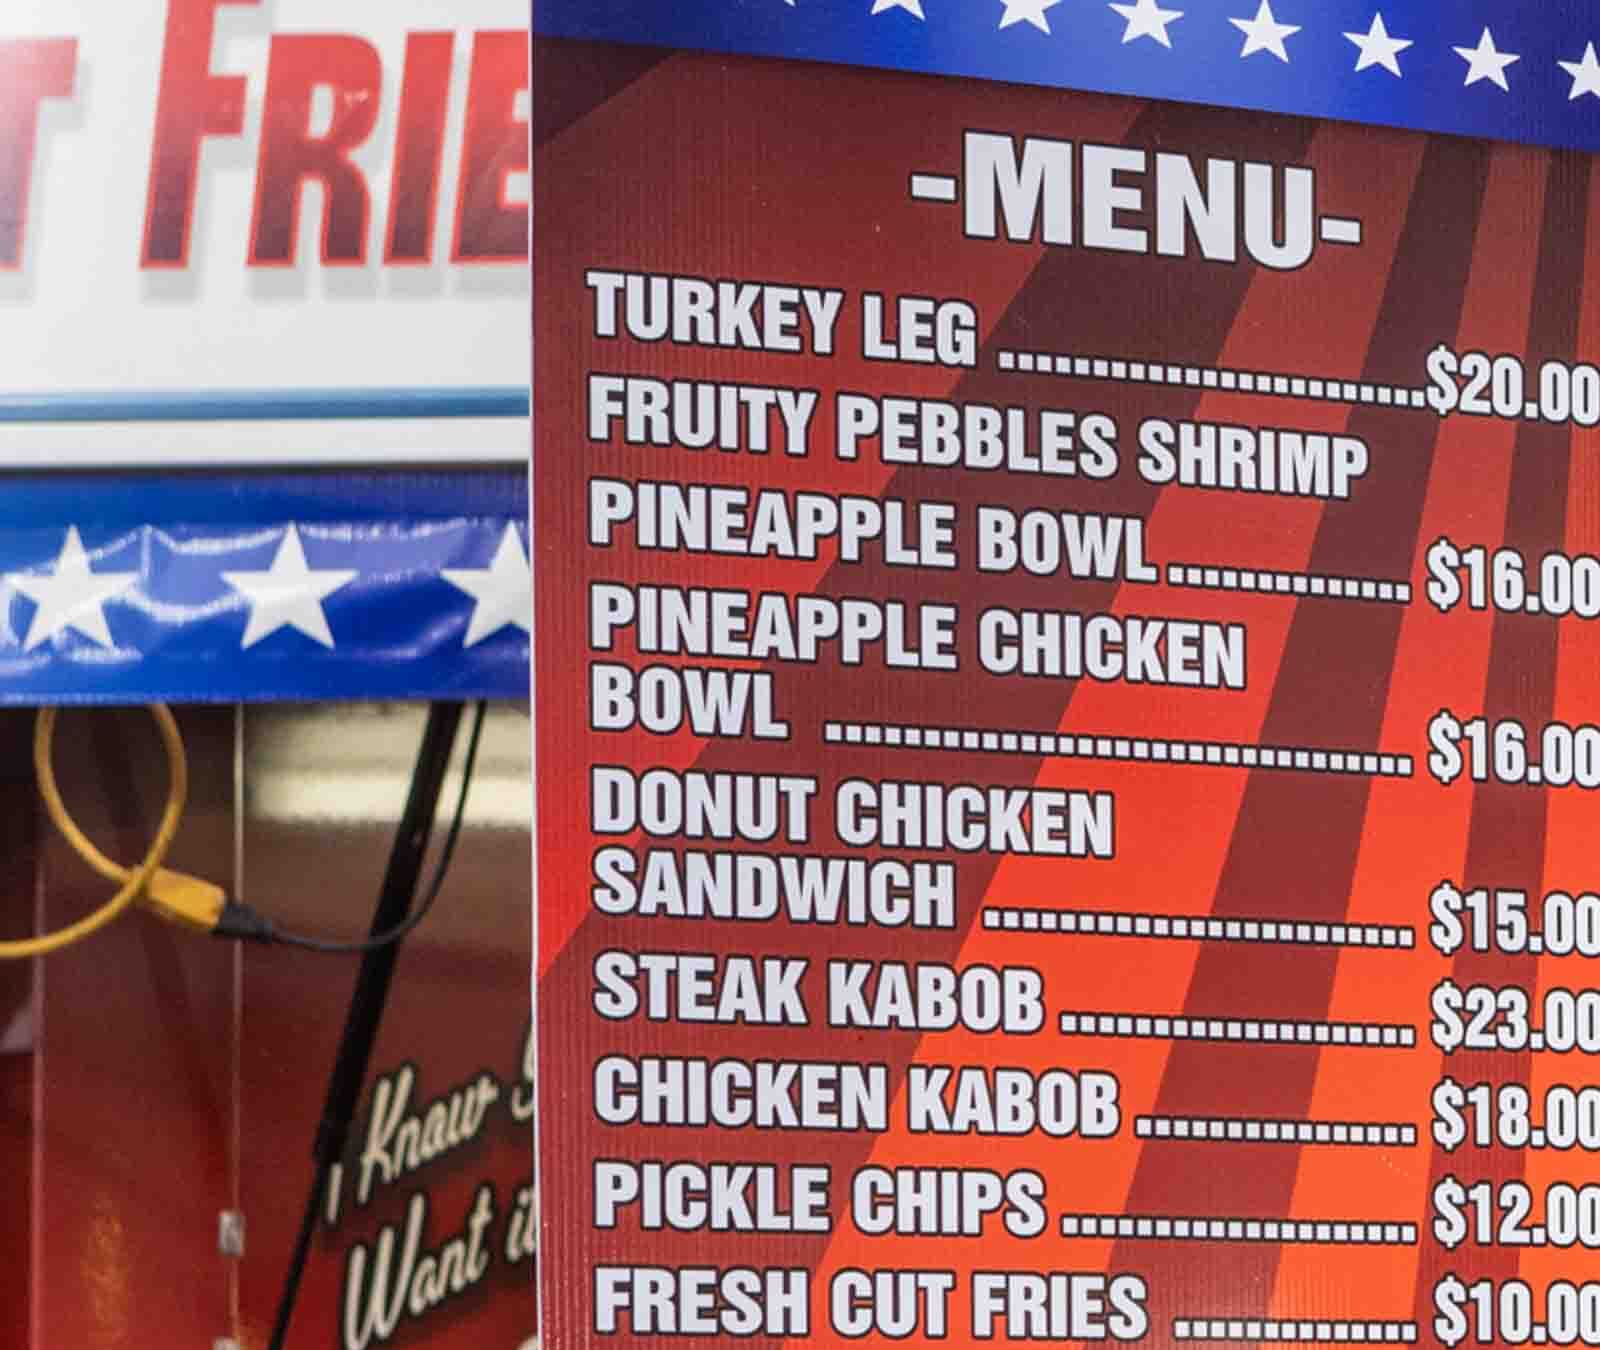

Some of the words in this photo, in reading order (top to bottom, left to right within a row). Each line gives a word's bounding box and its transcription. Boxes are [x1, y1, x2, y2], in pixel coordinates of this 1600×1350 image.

[584, 268, 846, 356] TURKEY
[861, 292, 978, 368] LEG
[587, 373, 820, 457] FRUITY
[835, 392, 1121, 480] PEBBLES
[1135, 417, 1371, 500] SHRIMP
[588, 477, 958, 570] PINEAPPLE
[975, 504, 1160, 584] BOWL
[588, 581, 959, 672] PINEAPPLE
[977, 606, 1247, 690] CHICKEN
[589, 661, 790, 746] BOWL
[590, 765, 818, 844] DONUT
[834, 778, 1115, 859] CHICKEN
[591, 846, 957, 929] SANDWICH
[592, 949, 810, 1026] STEAK
[827, 959, 1046, 1034] KABOB
[358, 1064, 498, 1205] Know
[592, 1054, 889, 1132] CHICKEN
[907, 1065, 1122, 1138] KABOB
[593, 1159, 832, 1234] PICKLE
[851, 1166, 1048, 1238] CHIPS
[593, 1265, 810, 1337] FRESH
[829, 1268, 956, 1339] CUT
[971, 1271, 1150, 1342] FRIES
